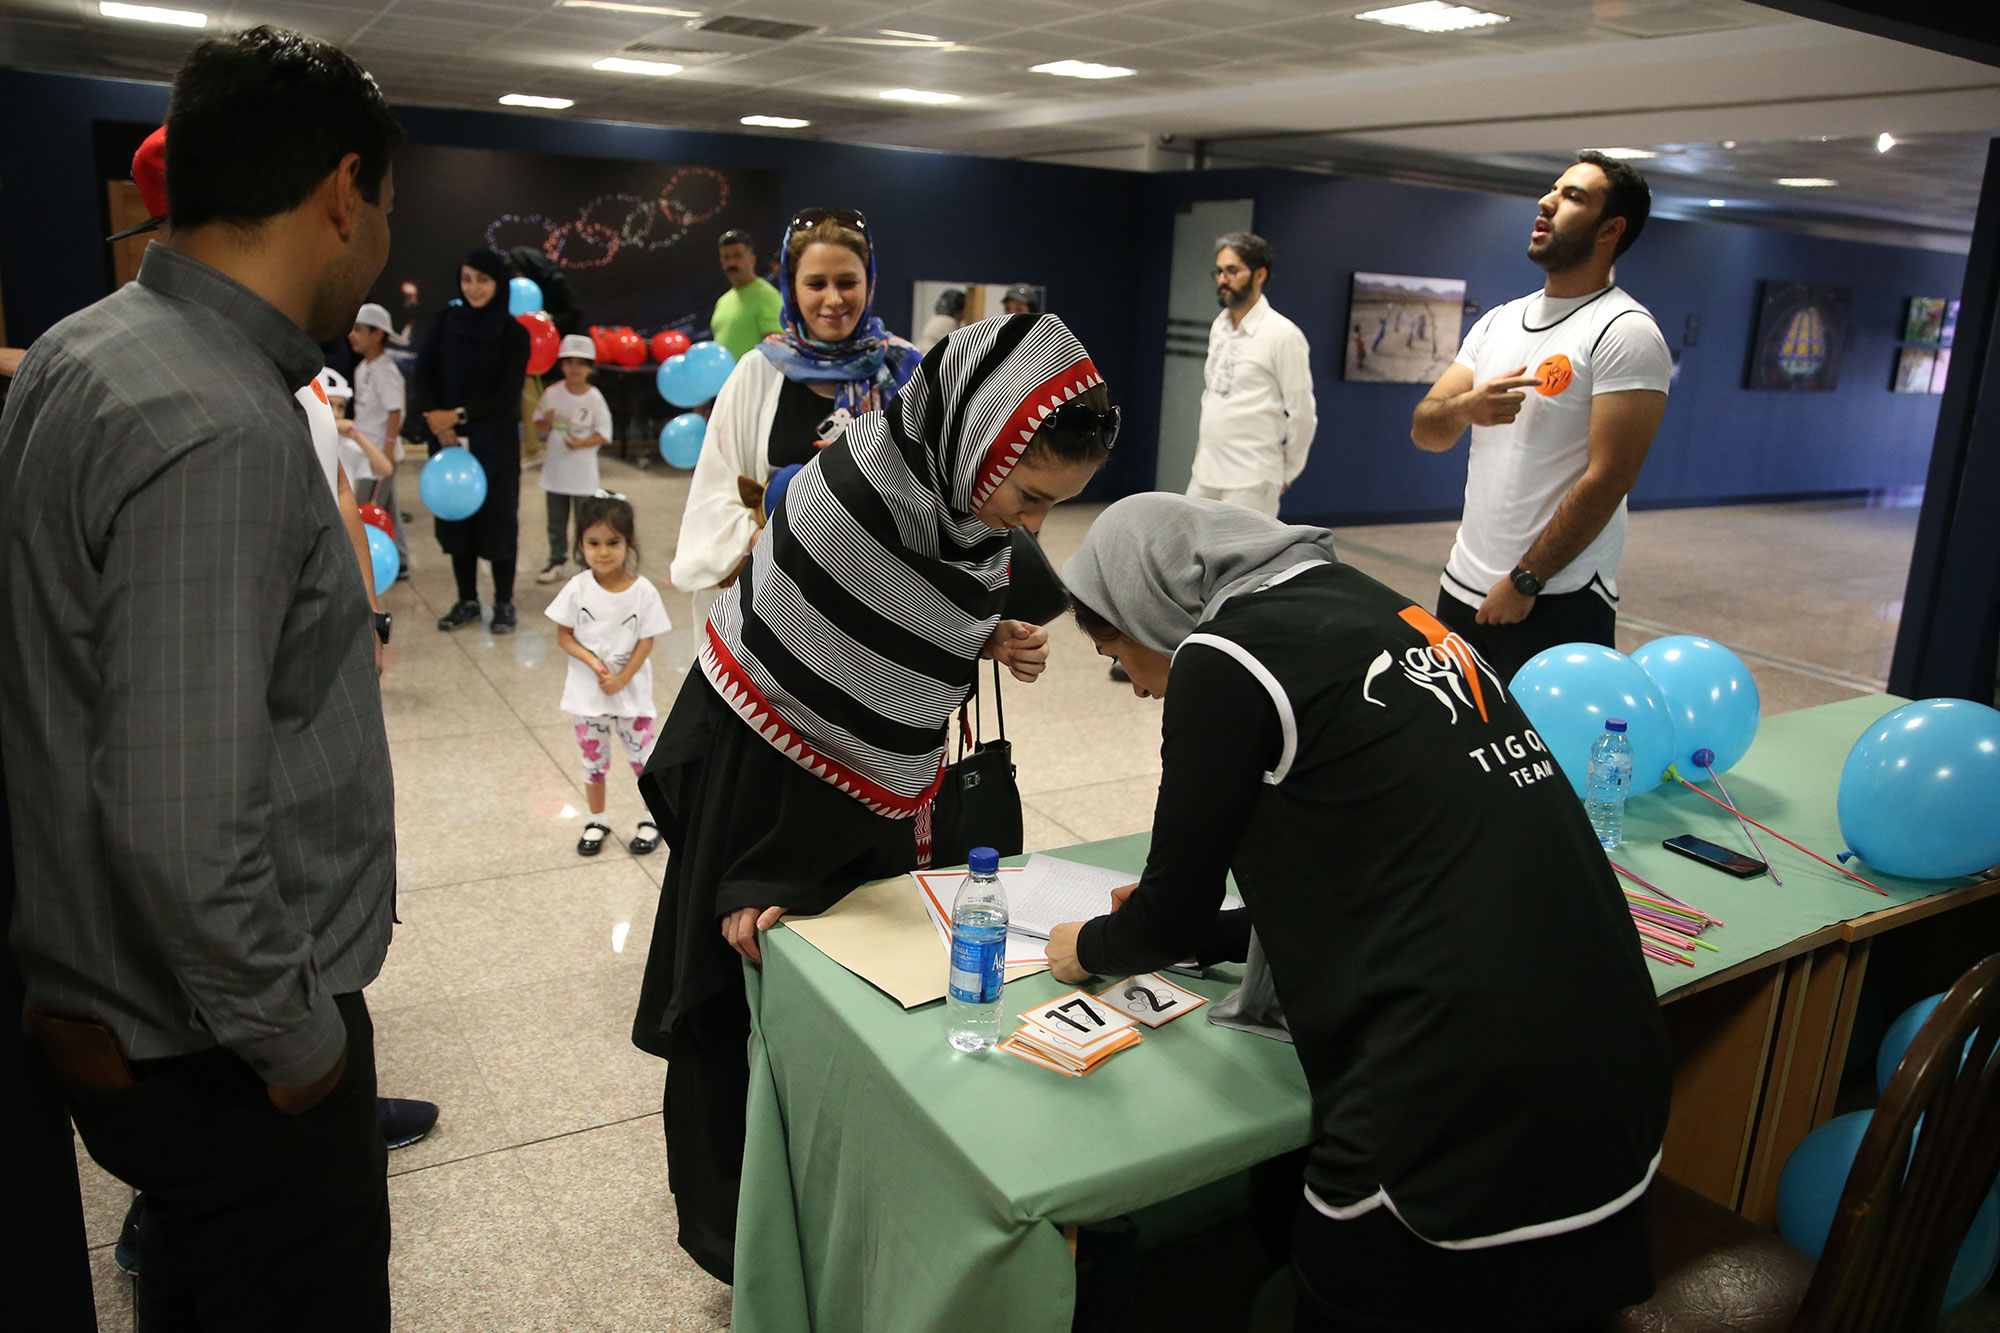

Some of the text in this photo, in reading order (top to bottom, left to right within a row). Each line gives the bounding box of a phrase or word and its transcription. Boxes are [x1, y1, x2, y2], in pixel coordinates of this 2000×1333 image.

[1468, 729, 1547, 772] TIGO
[1509, 760, 1554, 787] TEAM
[1124, 986, 1178, 1012] 2
[1045, 998, 1106, 1033] 17
